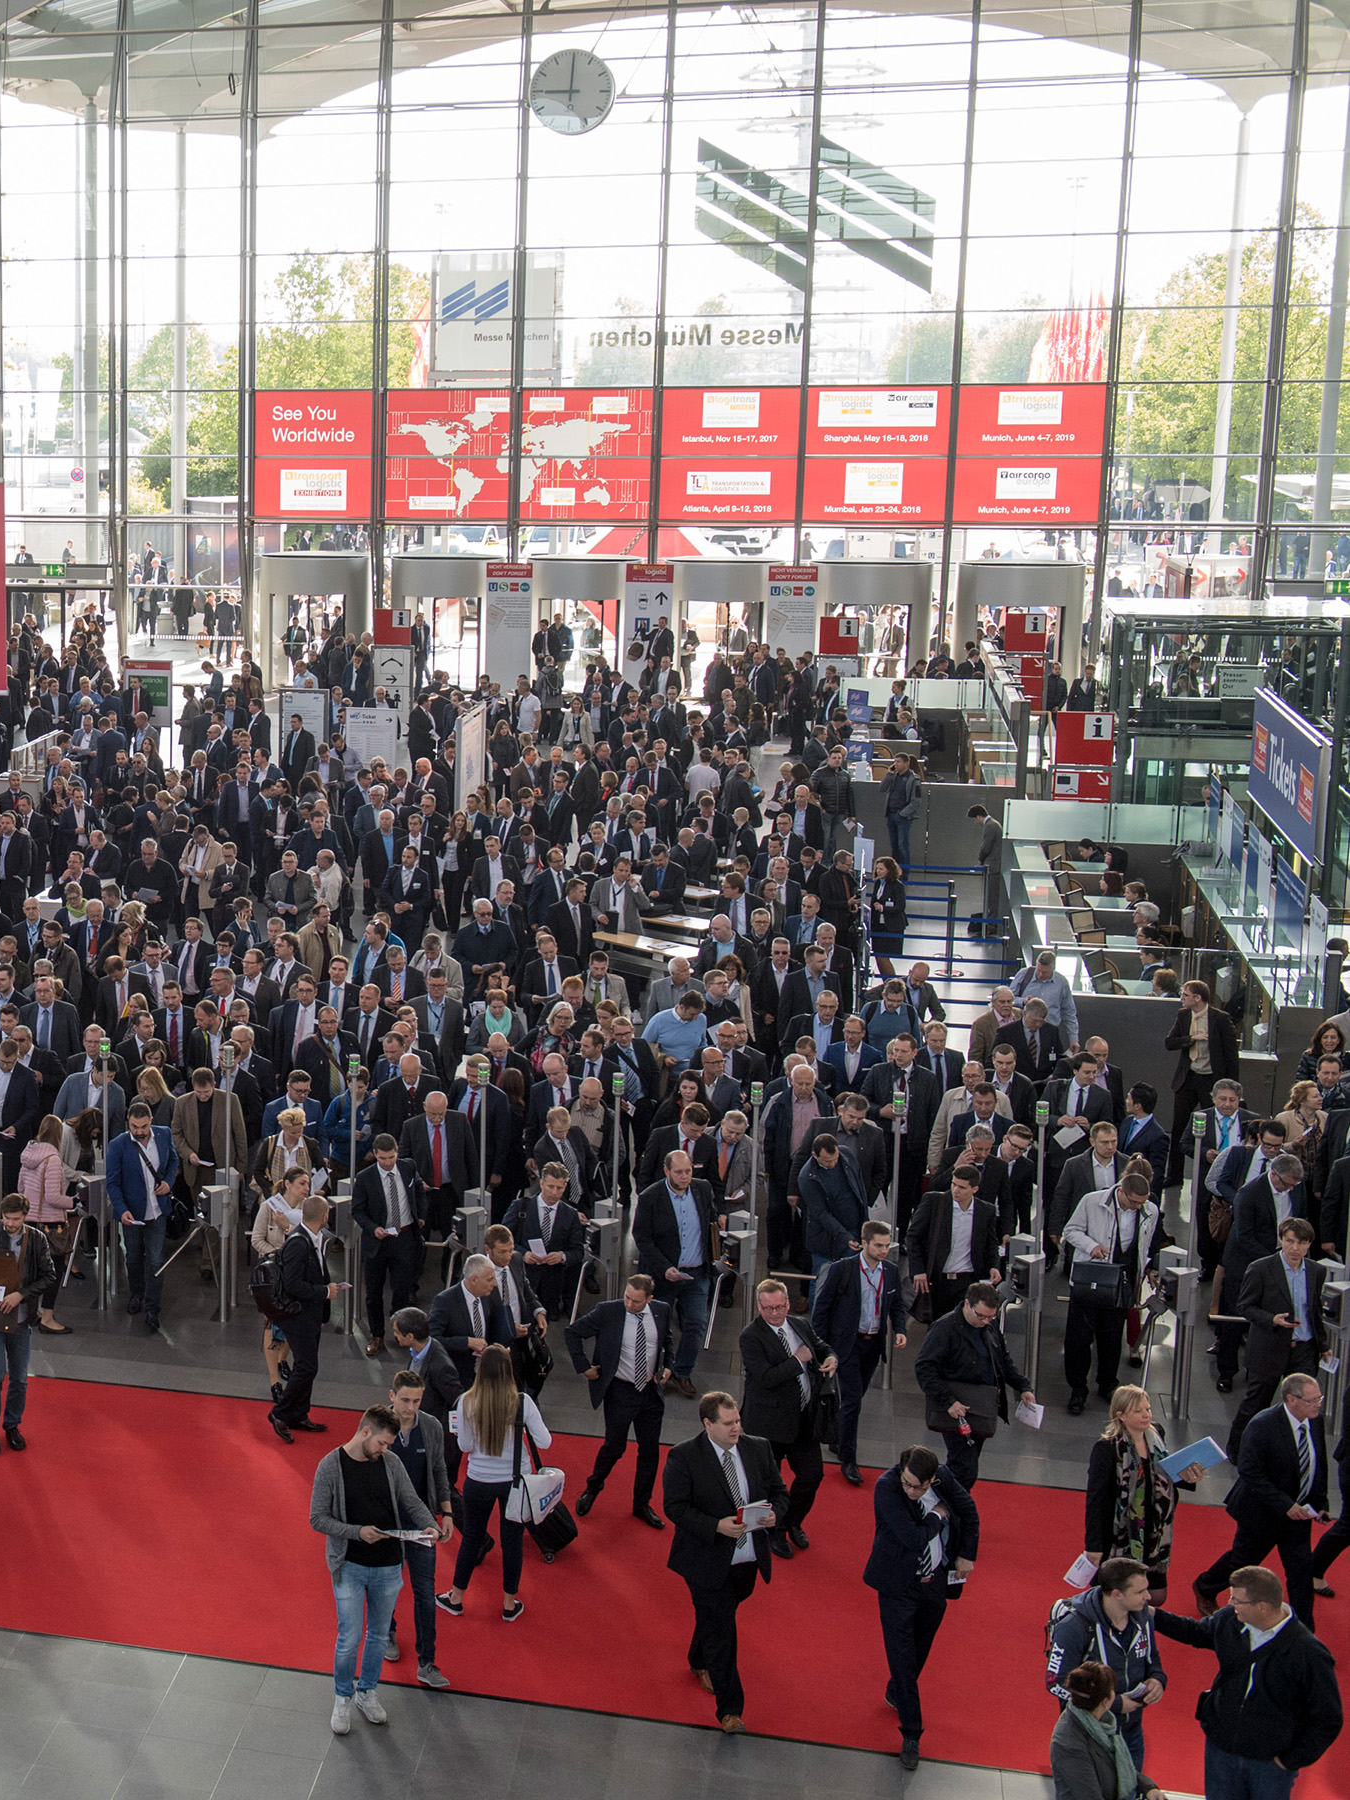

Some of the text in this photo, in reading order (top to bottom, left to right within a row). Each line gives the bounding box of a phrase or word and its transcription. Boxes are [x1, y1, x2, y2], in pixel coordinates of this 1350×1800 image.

[474, 333, 503, 342] Messe
[831, 394, 873, 403] transport
[896, 394, 935, 403] air cargo
[1012, 394, 1059, 405] transport
[841, 401, 873, 410] logistic
[1023, 402, 1059, 412] logistic
[272, 405, 337, 421] See You
[272, 427, 355, 442] Worldwide
[823, 434, 862, 443] Shanghai,
[863, 435, 881, 443] May
[909, 434, 928, 442] 2018
[982, 434, 1013, 443] Munich,
[1015, 434, 1035, 442] June
[1055, 433, 1075, 442] 2019
[682, 435, 714, 444] Istanbul,
[294, 471, 343, 483] transport
[1023, 472, 1051, 481] cargo
[306, 479, 343, 490] logistic
[682, 505, 711, 513] Atlanta,
[712, 505, 730, 513] April
[824, 505, 858, 514] Mumbai,
[978, 506, 1009, 514] Munich,
[1011, 506, 1031, 514] June
[1050, 506, 1071, 514] 2019
[490, 583, 497, 591] U
[772, 587, 779, 595] U
[1268, 733, 1297, 806] Tickets
[1047, 1641, 1065, 1675] DRY
